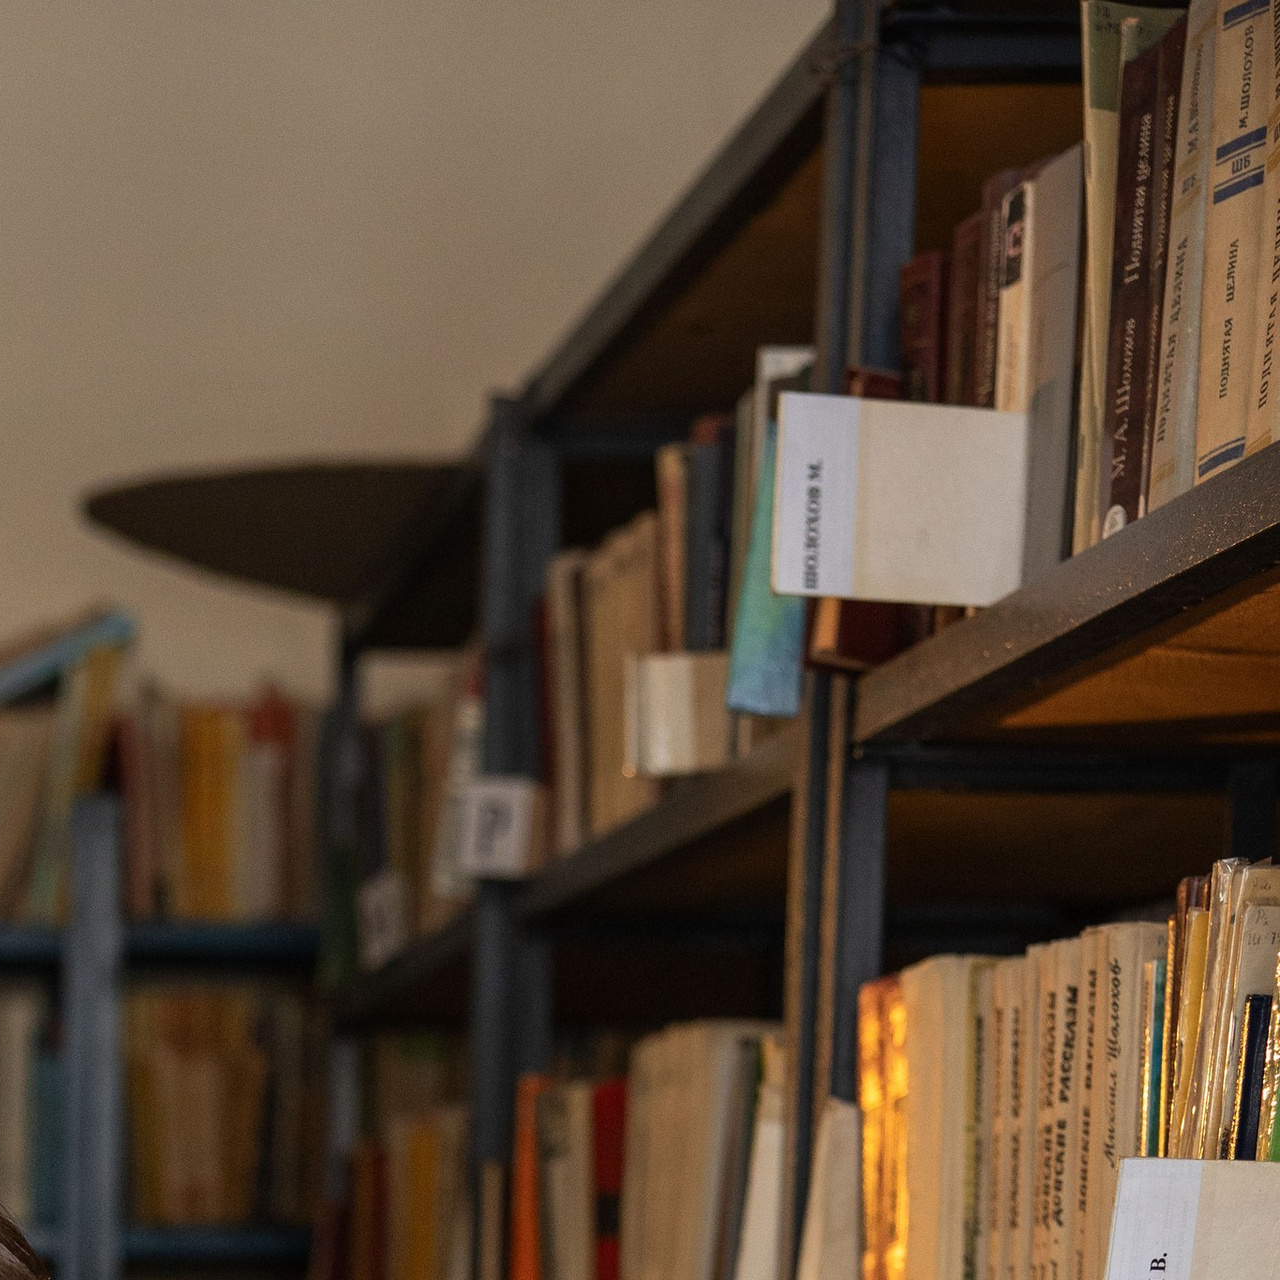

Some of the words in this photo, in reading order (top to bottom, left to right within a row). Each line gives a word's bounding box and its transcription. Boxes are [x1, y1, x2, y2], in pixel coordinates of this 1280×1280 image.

[1238, 24, 1255, 130] М.ШОЛОХОВ
[1225, 237, 1240, 303] ЦЕЛИНА
[1219, 316, 1234, 400] ПОДНЯТАЯ
[1257, 290, 1279, 411] ПОДНЯТАЯ
[1150, 1252, 1168, 1273] В.
